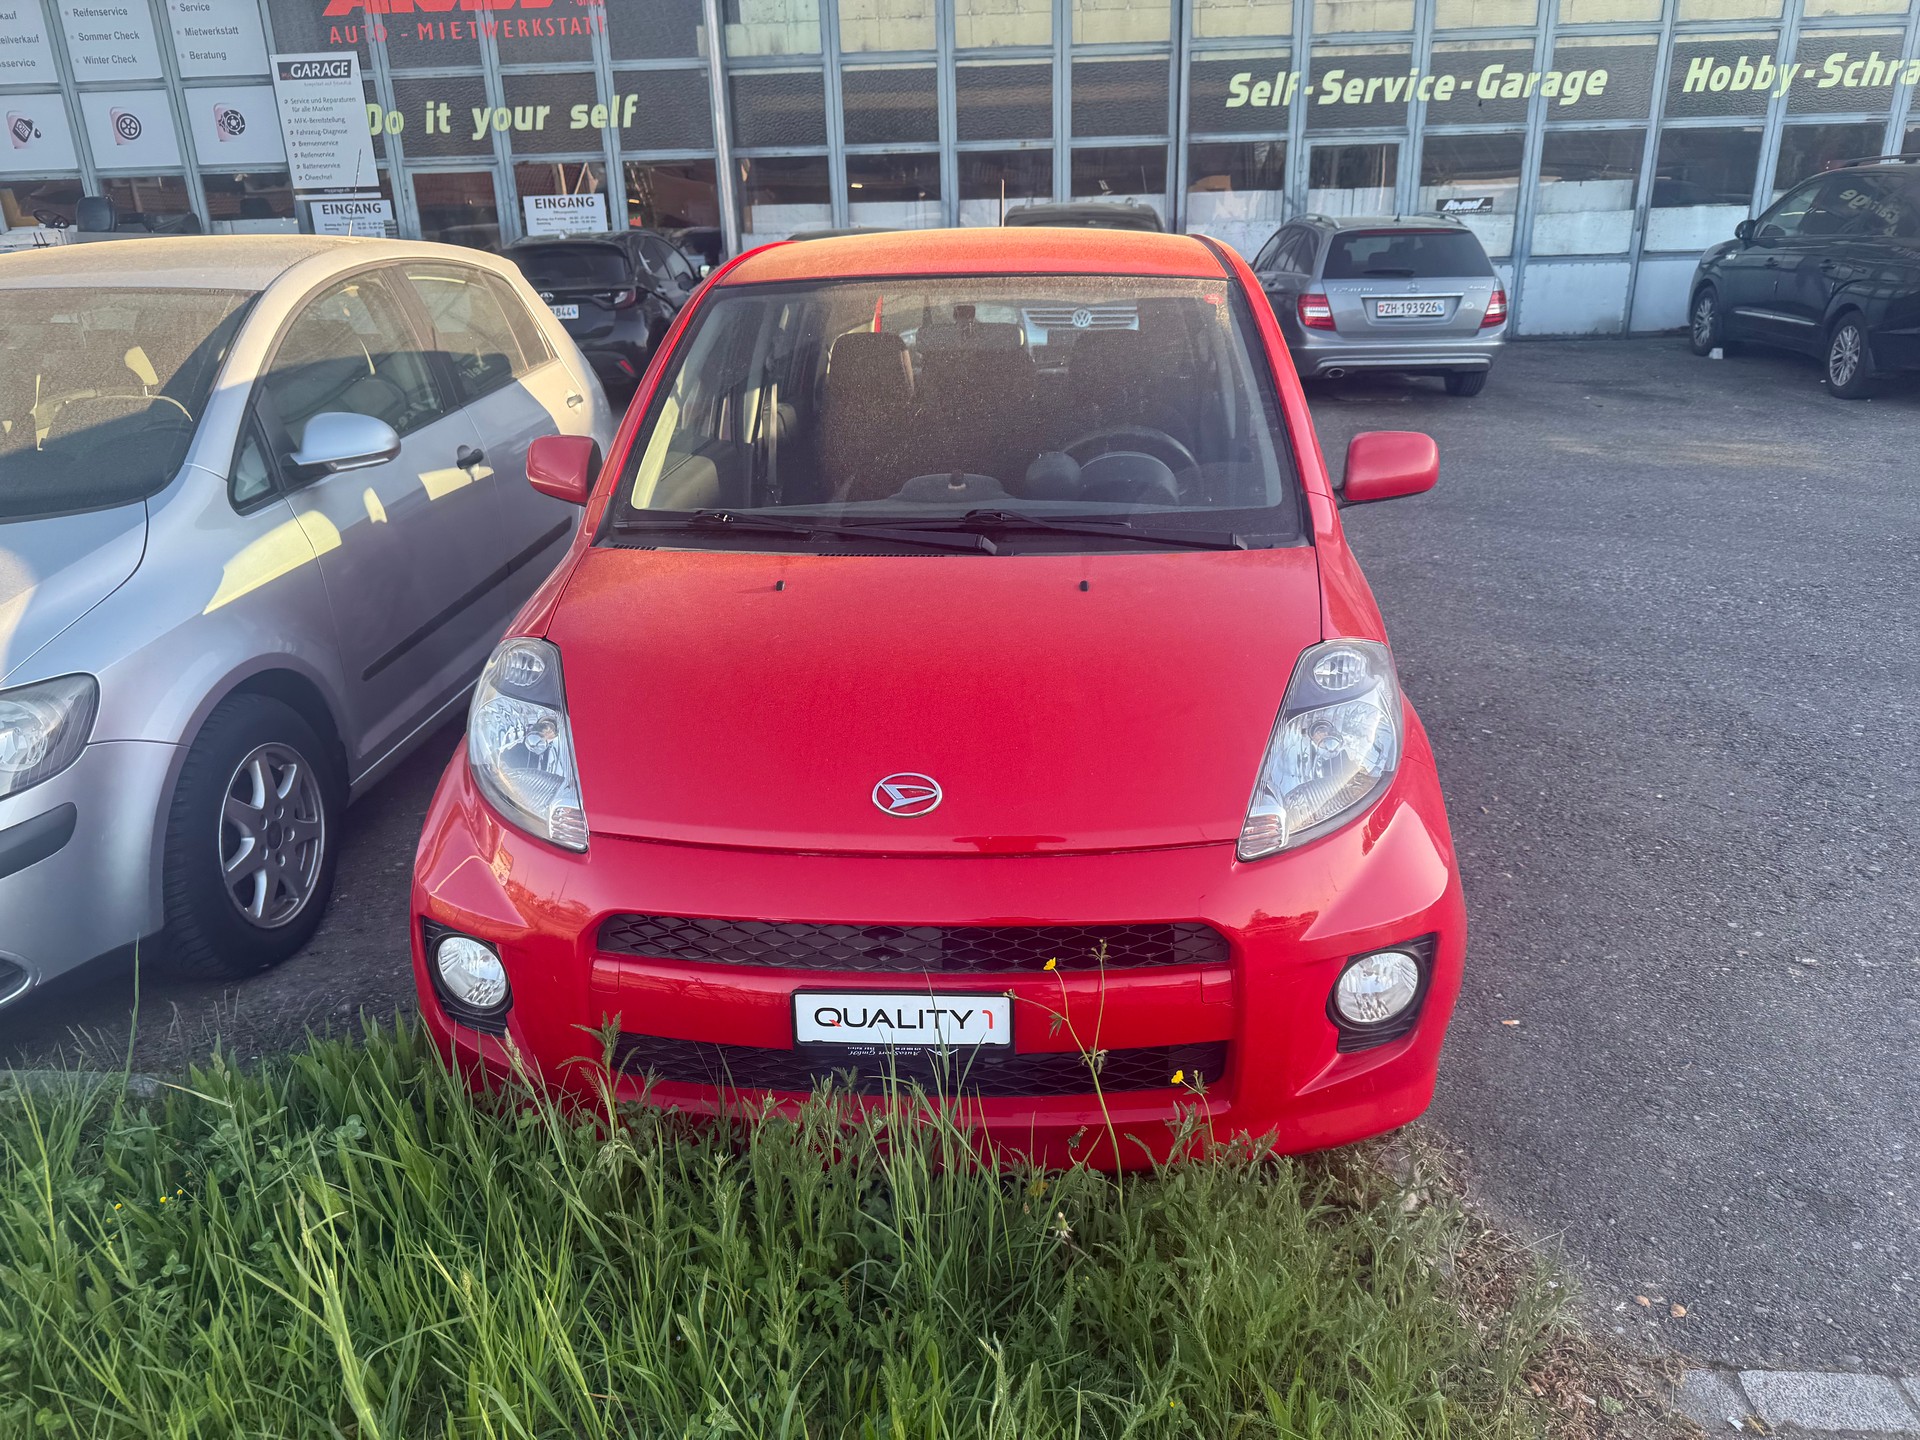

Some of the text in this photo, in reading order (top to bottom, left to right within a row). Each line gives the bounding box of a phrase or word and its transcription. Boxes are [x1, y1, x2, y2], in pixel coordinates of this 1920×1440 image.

[72, 7, 128, 18] Reifenservice
[180, 3, 210, 12] Service
[78, 30, 140, 42] Sommer Check
[184, 26, 239, 37] Mietwerkstatt
[330, 24, 388, 44] AUTO
[417, 16, 606, 41] MIETWERKSTATT
[83, 54, 138, 65] Winter Check
[189, 50, 227, 61] Beratung
[0, 58, 36, 68] sservice
[290, 62, 349, 78] GARAGE
[1225, 63, 1608, 108] Self-Service-Garage
[365, 94, 638, 141] Do it your self
[534, 196, 595, 209] EINGANG
[322, 203, 382, 215] EINGANG
[814, 1007, 974, 1030] QUALITY
